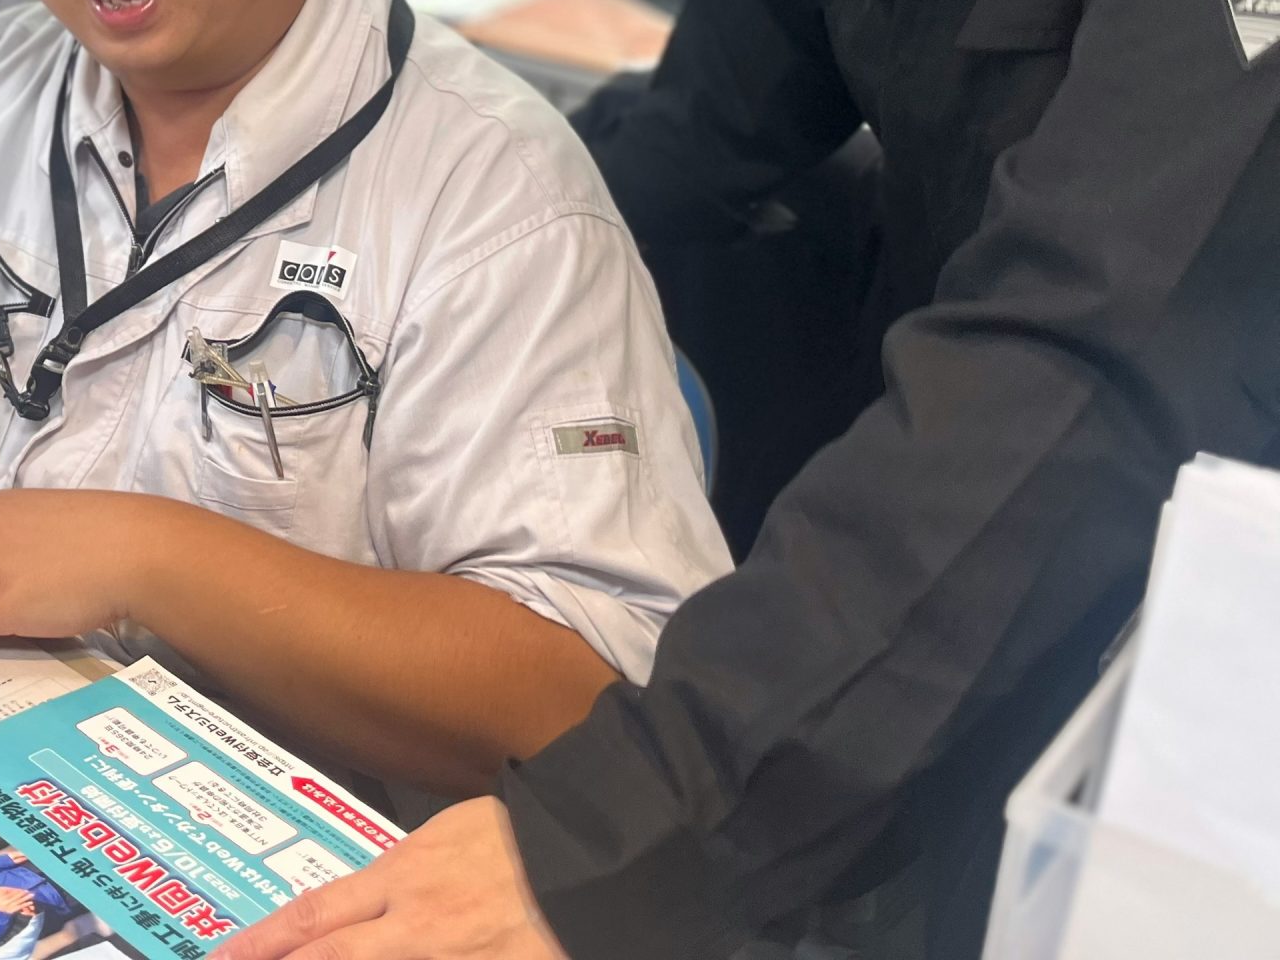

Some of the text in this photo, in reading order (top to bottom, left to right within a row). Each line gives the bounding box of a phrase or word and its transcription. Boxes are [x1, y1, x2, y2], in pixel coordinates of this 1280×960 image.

[168, 695, 286, 777] 立会受付Webシステム
[17, 779, 240, 940] 共同Web受付
